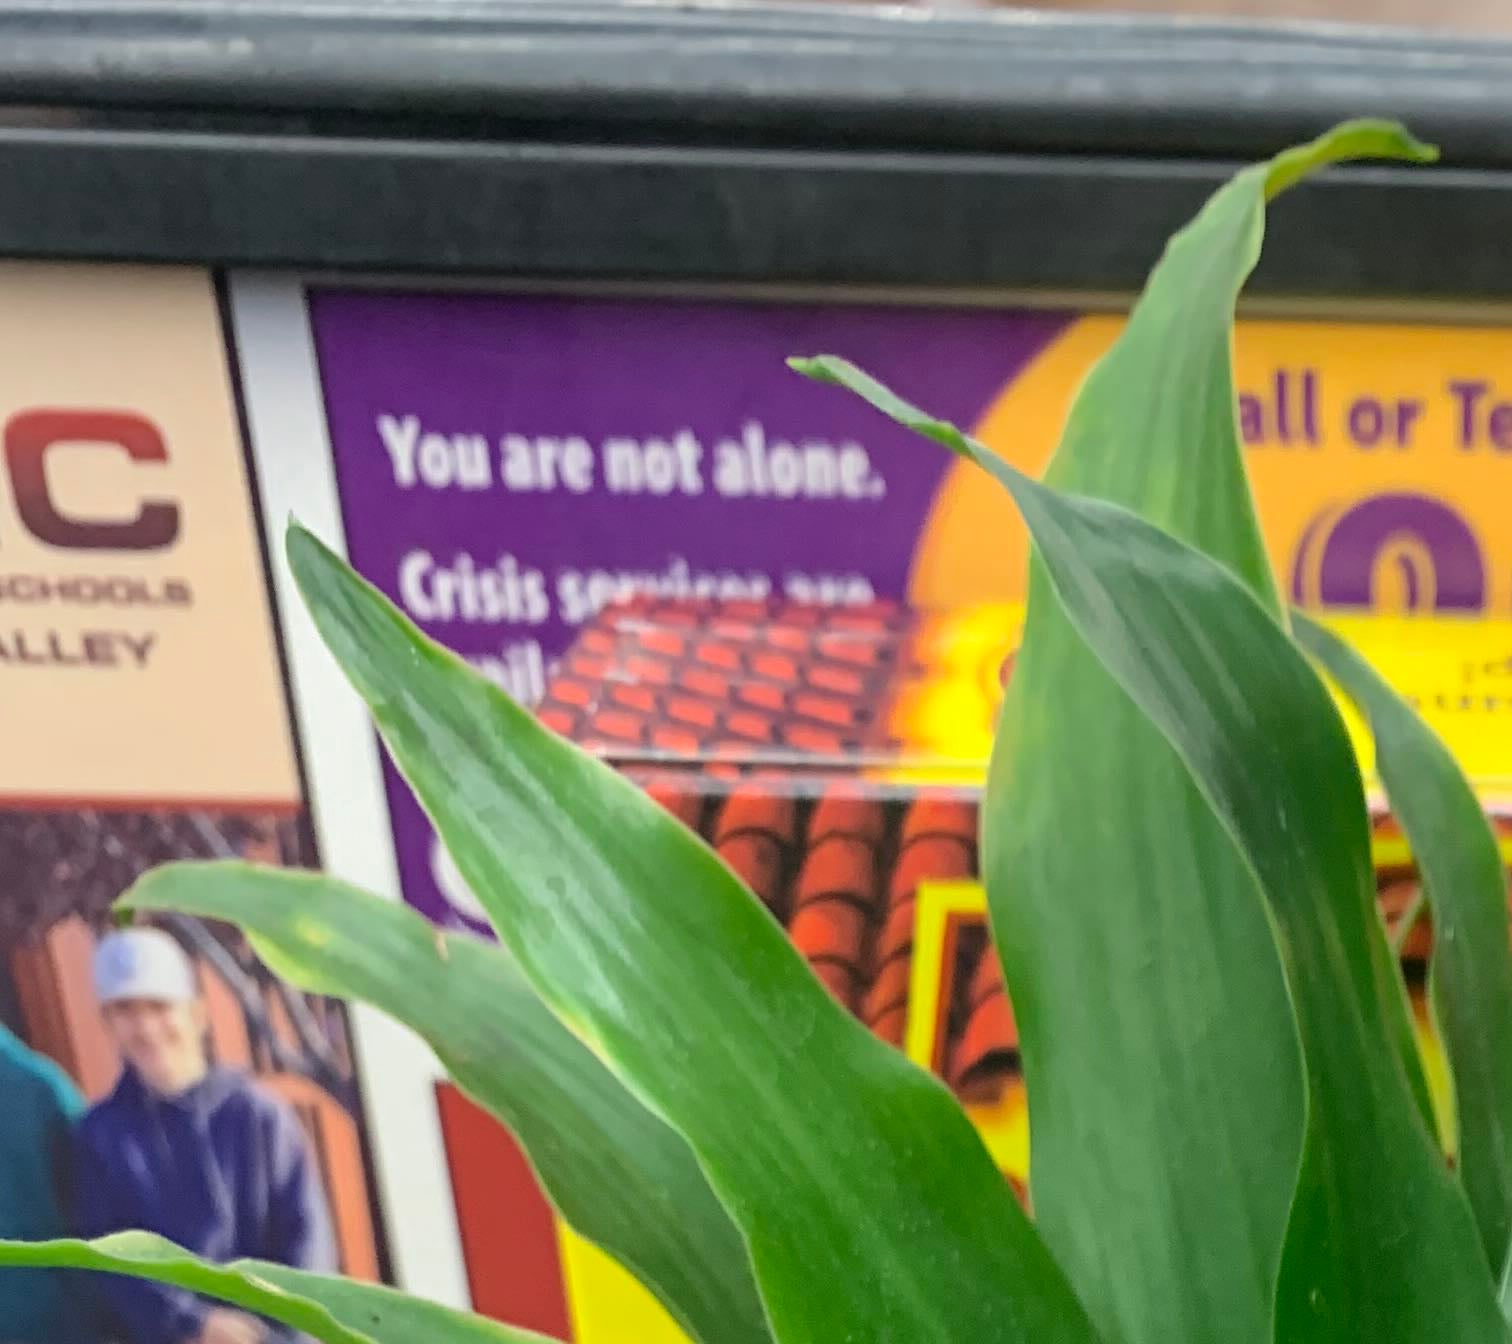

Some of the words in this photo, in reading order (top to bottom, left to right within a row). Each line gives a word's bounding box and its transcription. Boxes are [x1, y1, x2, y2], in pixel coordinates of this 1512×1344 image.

[1239, 368, 1317, 446] all
[1348, 394, 1421, 449] or
[377, 414, 492, 489] You
[502, 434, 595, 493] are
[603, 428, 703, 496] not
[714, 420, 886, 500] alone.
[400, 549, 549, 625] Crisis
